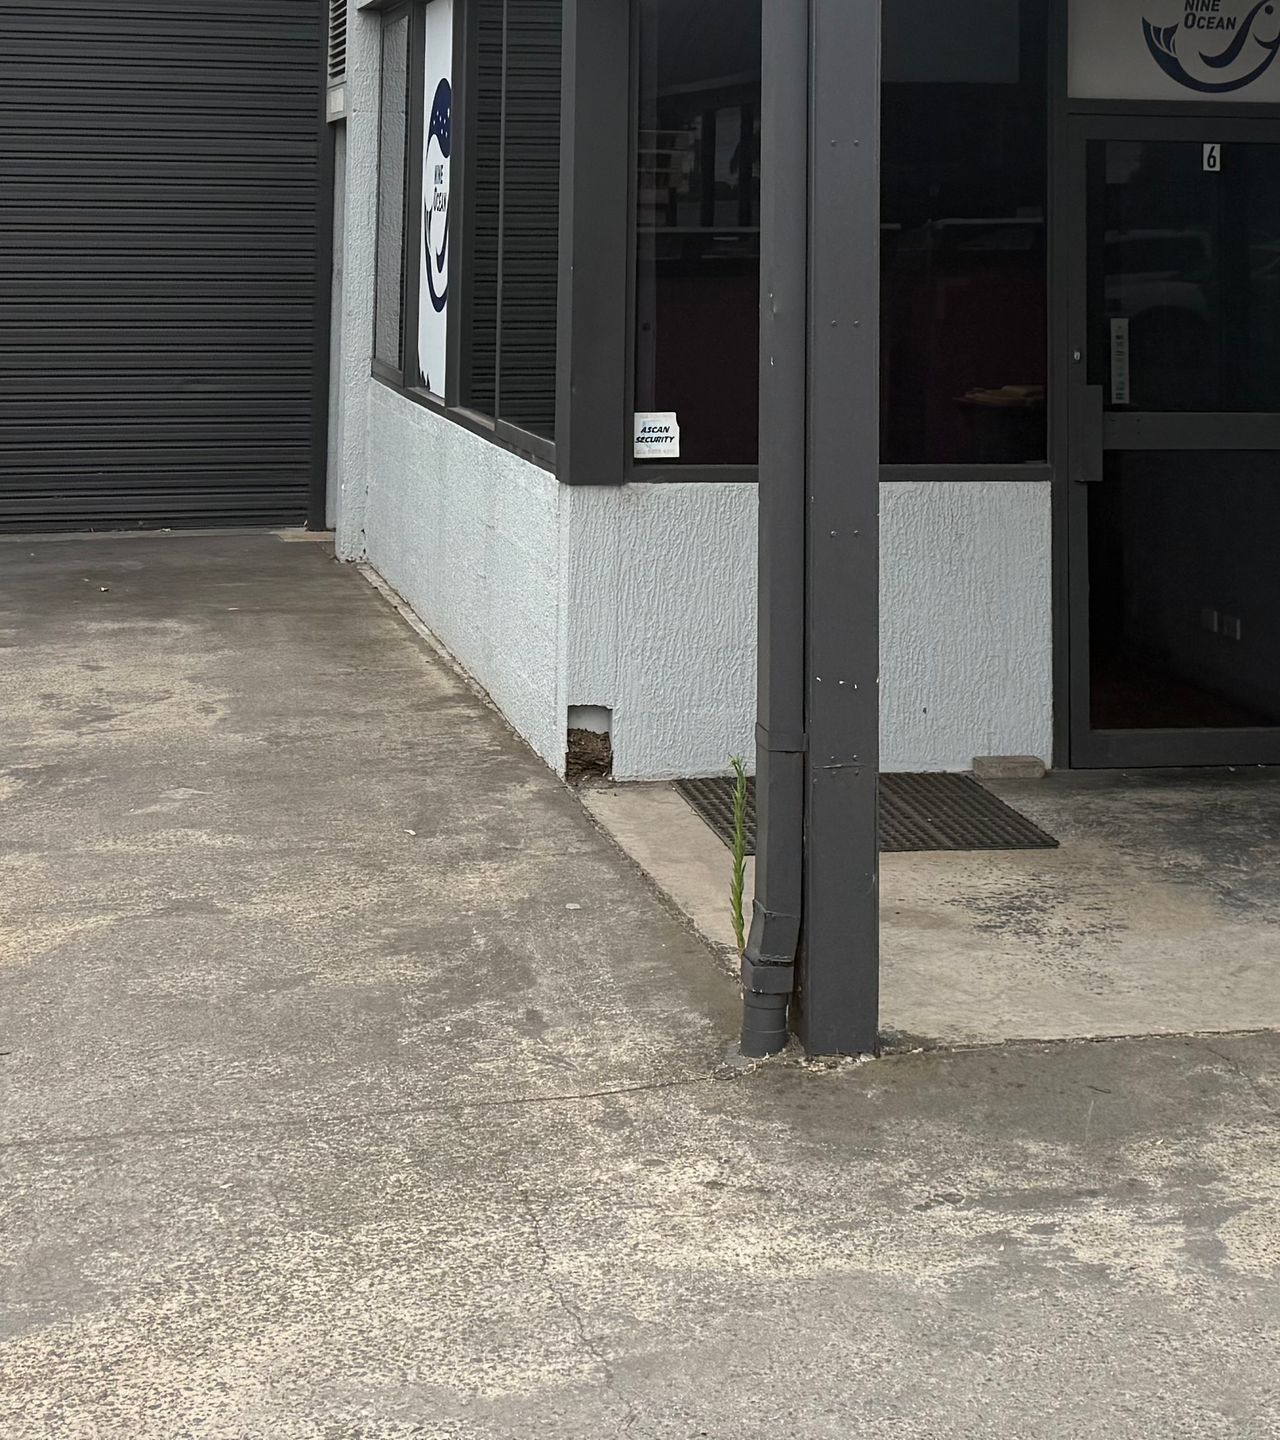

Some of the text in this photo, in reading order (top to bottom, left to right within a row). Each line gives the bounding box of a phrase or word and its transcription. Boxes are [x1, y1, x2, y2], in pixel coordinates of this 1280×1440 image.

[1183, 12, 1237, 30] OCEAN
[1207, 145, 1217, 168] 6
[640, 426, 670, 434] ASCAN
[635, 435, 675, 444] SECURITY
